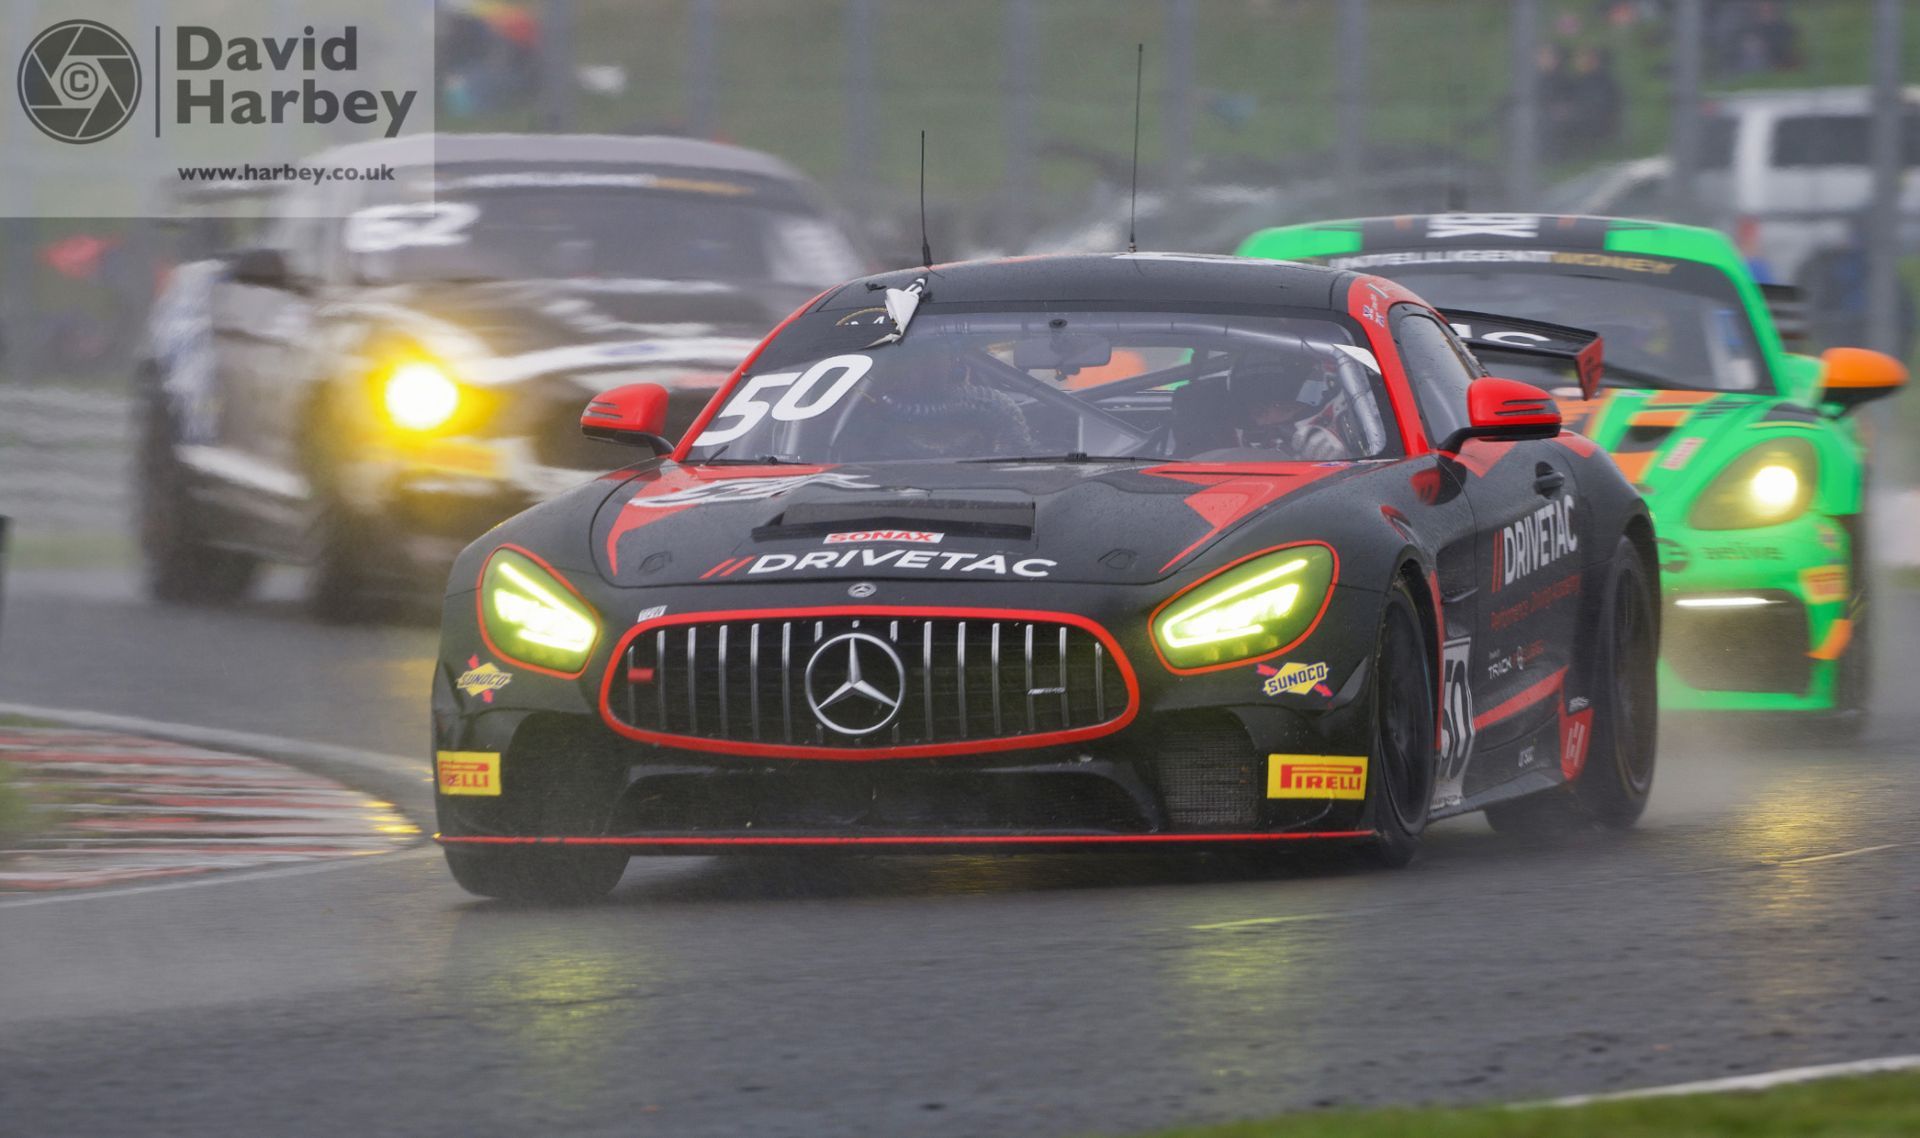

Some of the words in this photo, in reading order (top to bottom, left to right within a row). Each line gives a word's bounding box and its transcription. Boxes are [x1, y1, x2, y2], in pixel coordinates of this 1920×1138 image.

[692, 354, 873, 446] 50
[826, 531, 935, 543] SONAX
[1503, 494, 1578, 585] DRIVETAC
[748, 549, 1058, 577] DRIVETAC
[460, 672, 510, 687] SUNOCO
[1267, 665, 1326, 694] SUNOCO
[1280, 764, 1363, 791] PIRELLI
